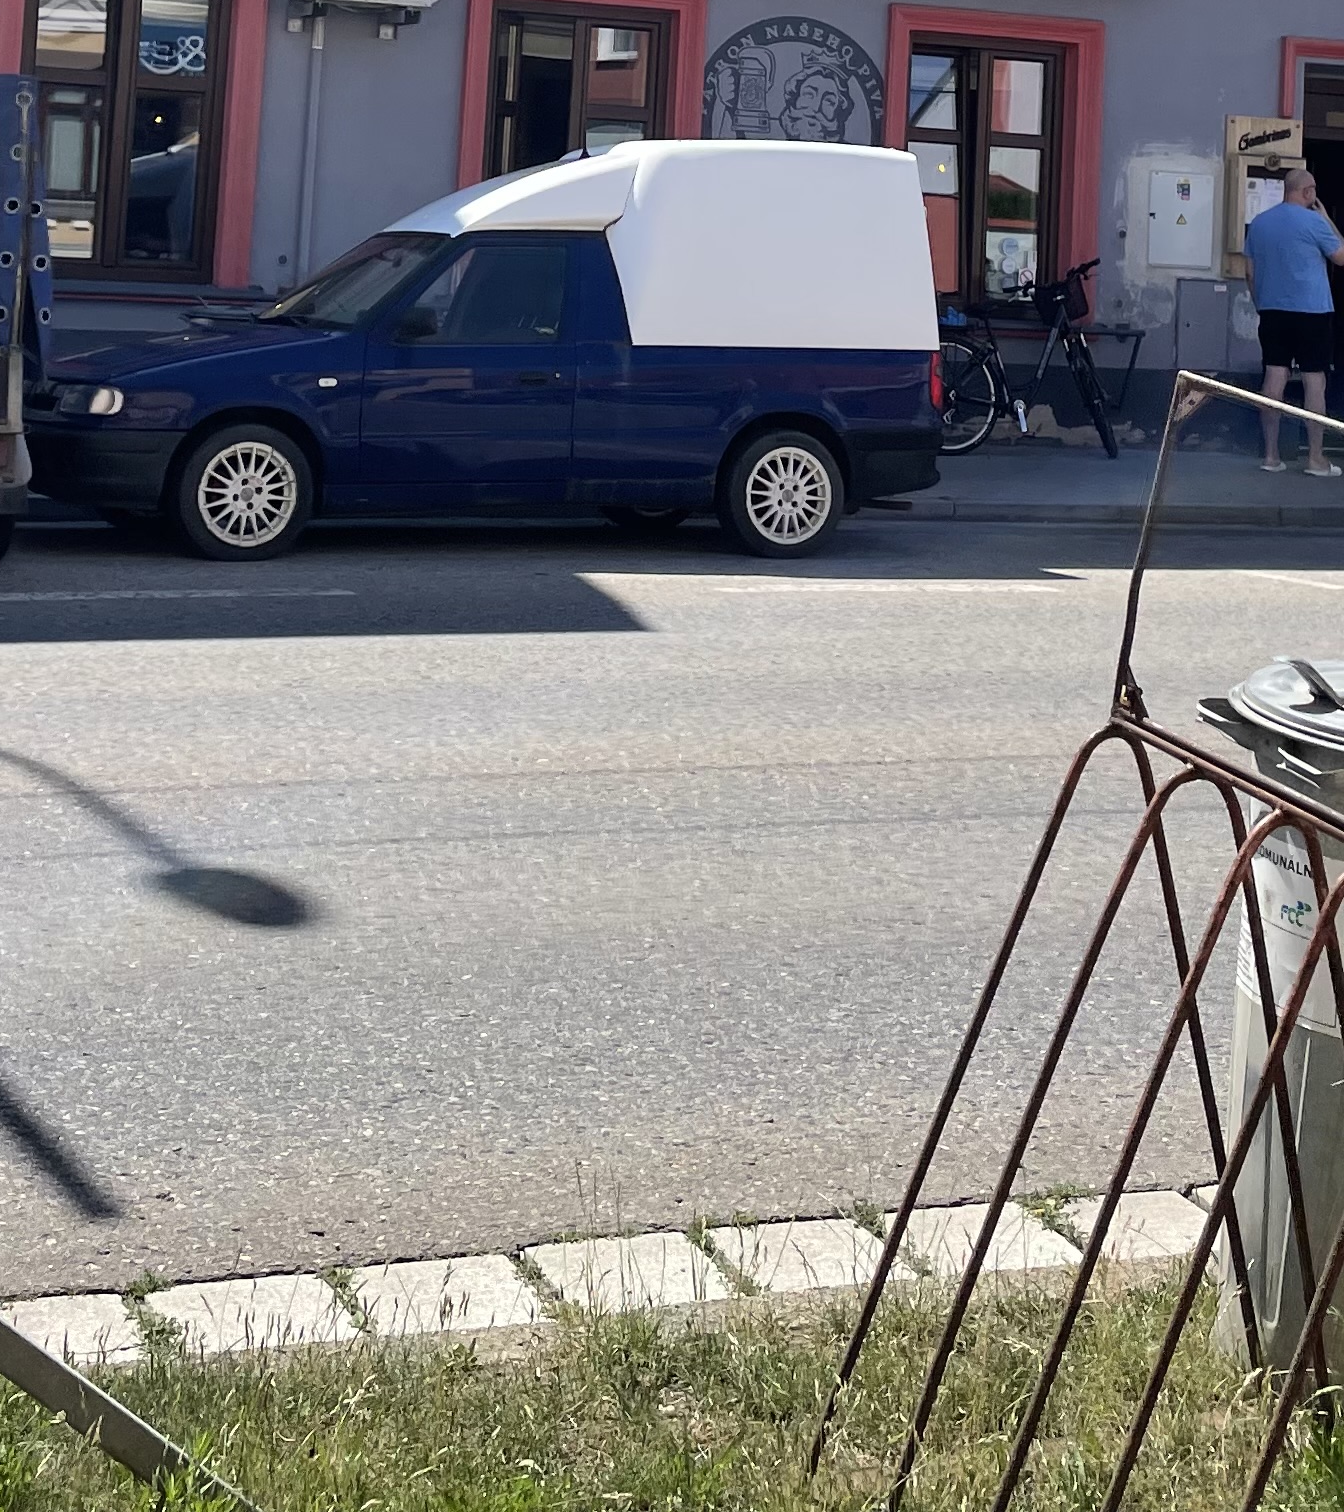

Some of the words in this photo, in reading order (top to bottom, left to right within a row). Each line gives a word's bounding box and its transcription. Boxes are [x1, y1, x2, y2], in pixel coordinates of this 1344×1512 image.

[764, 23, 854, 58] NAŠEHO
[857, 63, 884, 120] PIVA
[1281, 904, 1305, 928] FCC
